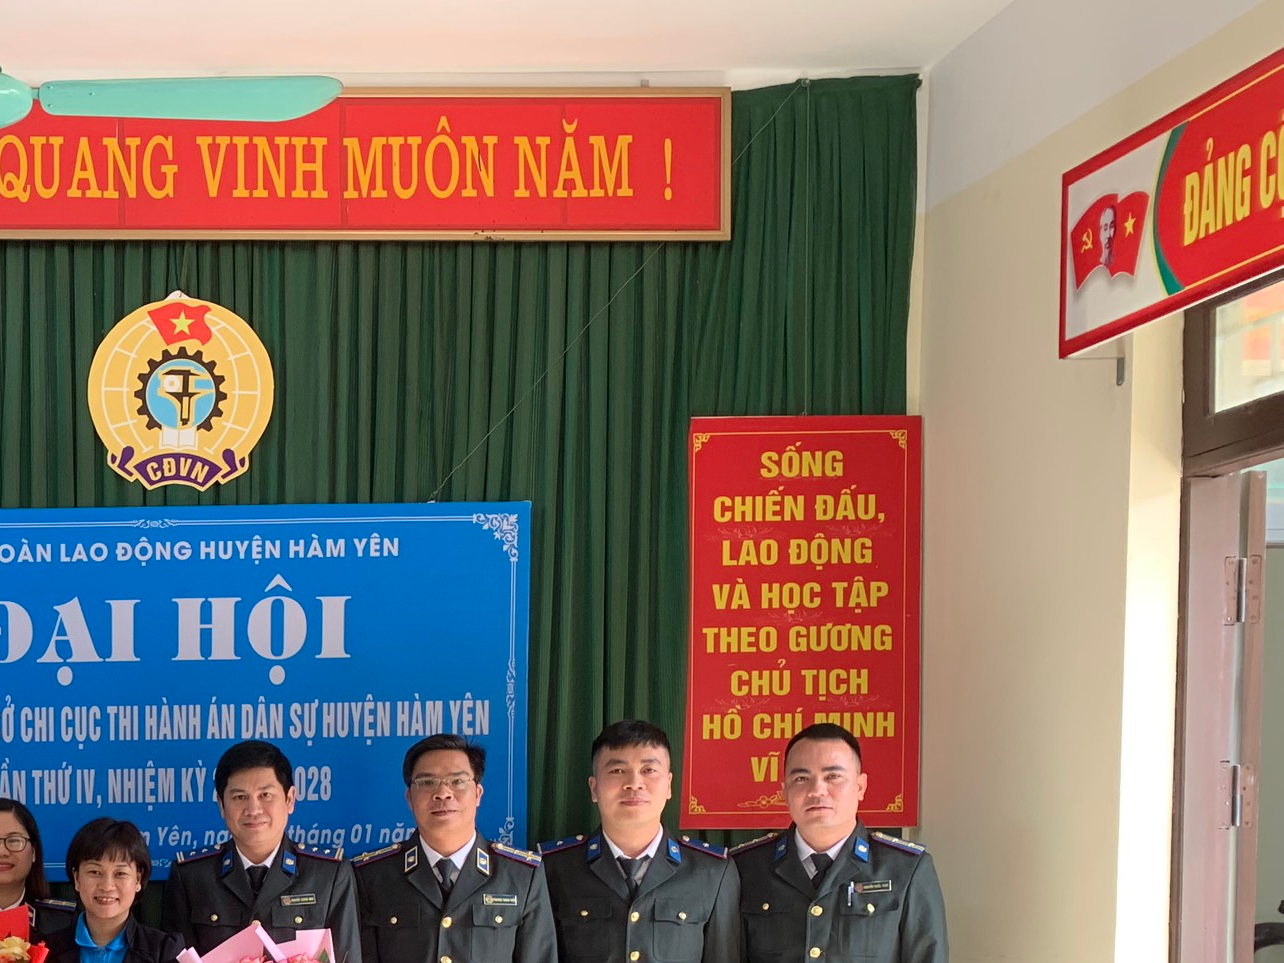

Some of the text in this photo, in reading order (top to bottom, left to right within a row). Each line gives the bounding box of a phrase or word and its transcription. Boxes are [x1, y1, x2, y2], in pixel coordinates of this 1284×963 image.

[196, 136, 328, 198] VINH
[343, 116, 497, 199] MUÔN
[514, 119, 633, 197] NĂM
[663, 138, 674, 200] !
[1183, 137, 1252, 247] ĐẢNG
[146, 457, 209, 484] CĐVN
[761, 442, 842, 477] SỐNG
[714, 485, 884, 522] CHIẾN ĐẤU,
[61, 543, 108, 562] LAO
[116, 537, 192, 565] ĐỘNG
[201, 535, 280, 564] HUYỆN
[290, 534, 345, 558] HÀM
[354, 533, 398, 556] YÊN
[723, 533, 871, 570] LAO ĐỘNG
[713, 577, 888, 614] VÀ HỌC TẬP
[172, 574, 351, 685] HỘI
[703, 623, 891, 652] THEO GƯƠNG
[731, 659, 867, 700] CHỦ TỊCH
[21, 707, 54, 742] CHI
[61, 706, 100, 749] CỤC
[107, 706, 138, 740] THI
[146, 698, 200, 740] HÀNH
[207, 697, 234, 739] ÁN
[242, 696, 283, 739] DÂN
[290, 699, 318, 746] SỰ
[323, 694, 390, 745] HUYỆN
[397, 693, 443, 736] HÀM
[450, 693, 489, 735] YÊN
[703, 705, 741, 739] HỒ
[753, 708, 802, 738] CHÍ
[750, 751, 780, 782] VĨ
[32, 761, 72, 805] THỨ
[76, 769, 102, 808] IV,
[108, 760, 175, 811] NHIỆM
[181, 760, 207, 803] KỲ
[157, 825, 197, 849] Yên,
[288, 823, 346, 848] tháng
[350, 824, 372, 844] 01
